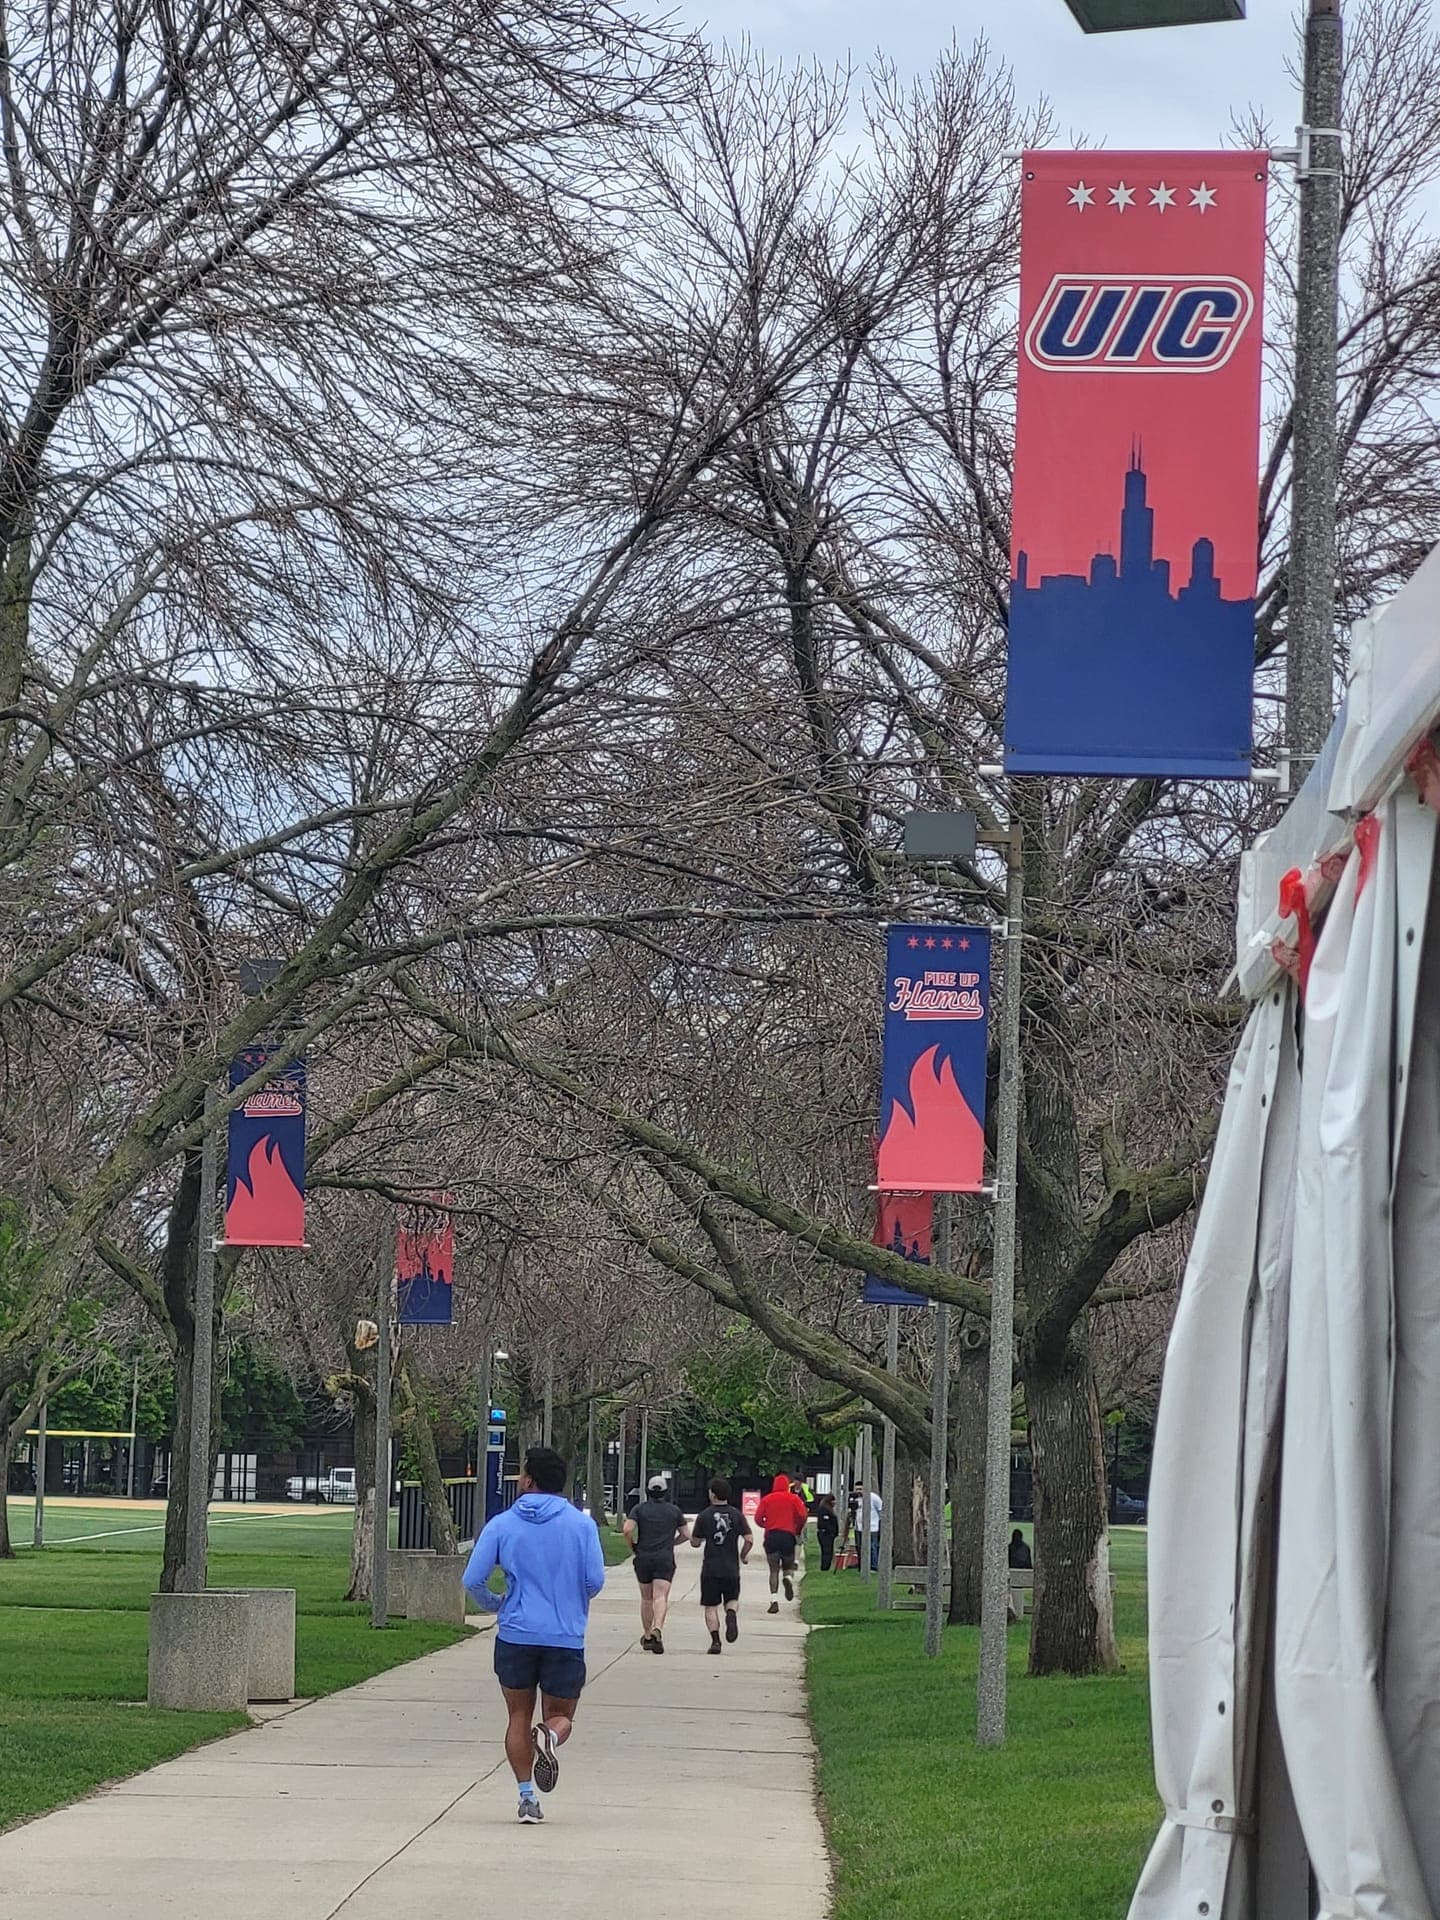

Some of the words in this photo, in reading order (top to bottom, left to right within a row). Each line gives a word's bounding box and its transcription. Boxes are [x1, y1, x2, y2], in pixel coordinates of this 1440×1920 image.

[1038, 285, 1243, 362] UIC
[889, 977, 981, 1012] Flames
[924, 971, 957, 987] FIRE
[960, 973, 980, 987] UP
[496, 1452, 504, 1495] Emergency
